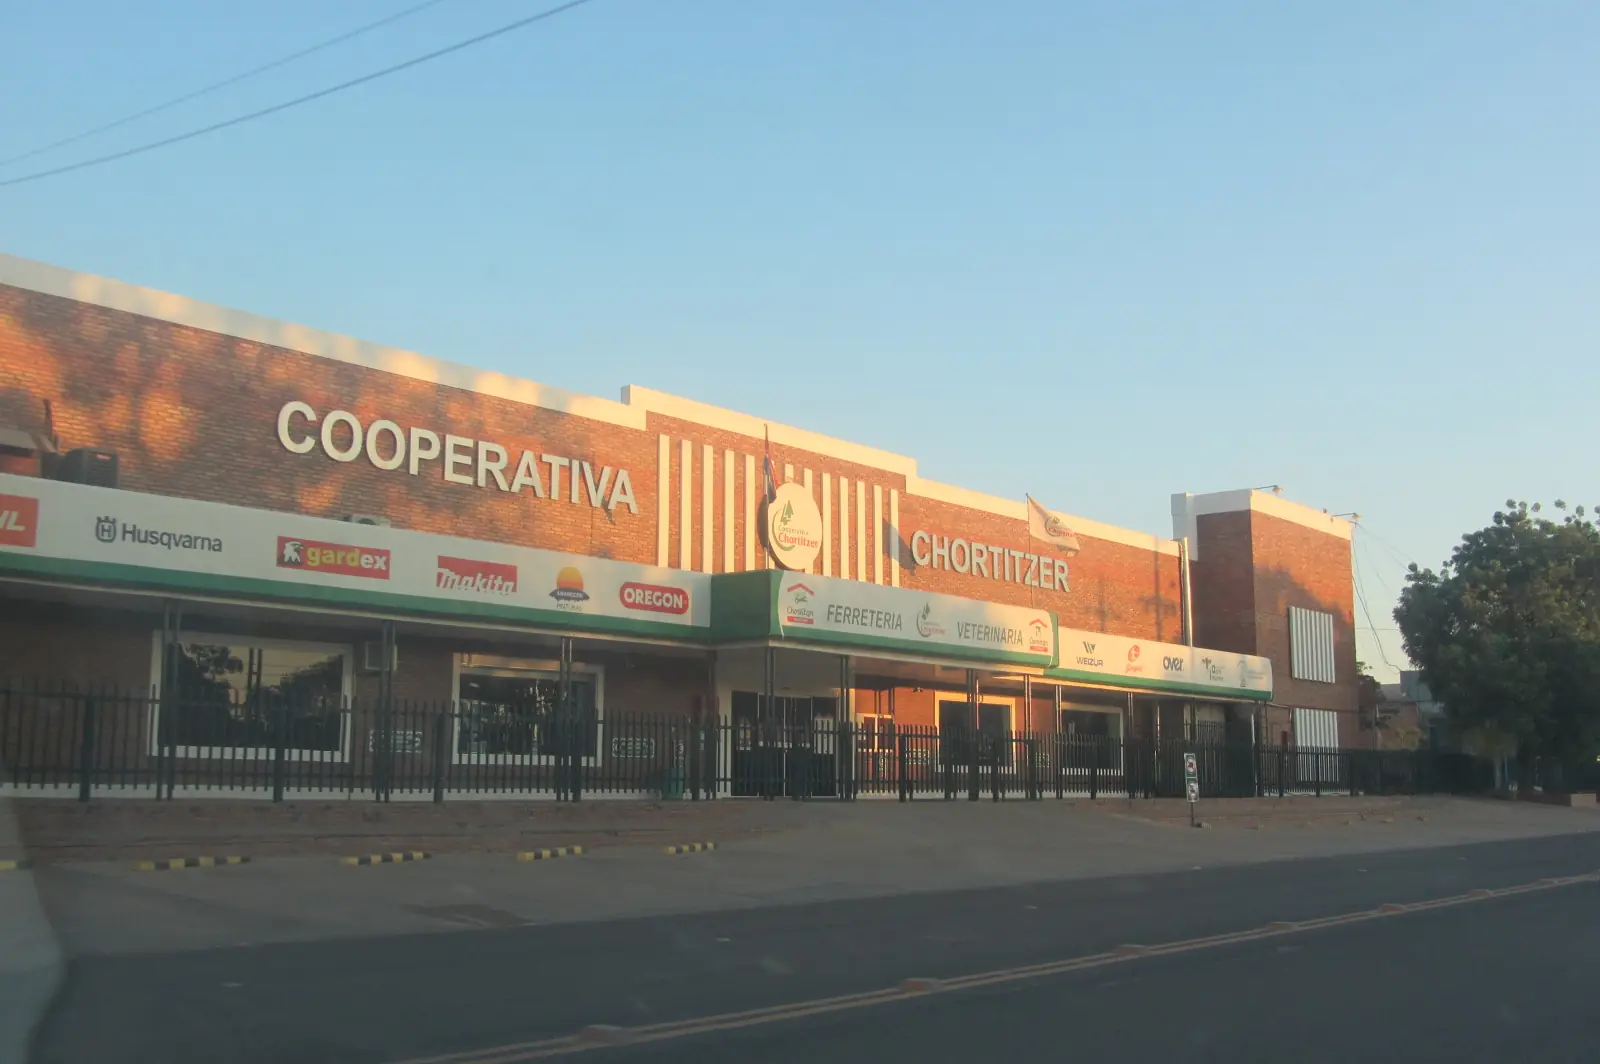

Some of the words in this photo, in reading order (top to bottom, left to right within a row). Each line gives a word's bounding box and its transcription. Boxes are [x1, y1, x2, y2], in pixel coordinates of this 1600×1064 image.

[277, 400, 639, 515] COOPERATIVA
[121, 523, 223, 552] Husqvarna
[778, 532, 819, 549] Chortitzer
[307, 547, 388, 571] gardex
[911, 529, 1071, 593] CHORTITZER
[623, 587, 684, 609] OREGON
[827, 604, 903, 631] FERRETERIA
[957, 621, 1024, 646] VETERINARIA
[1076, 656, 1104, 667] WEIZUR
